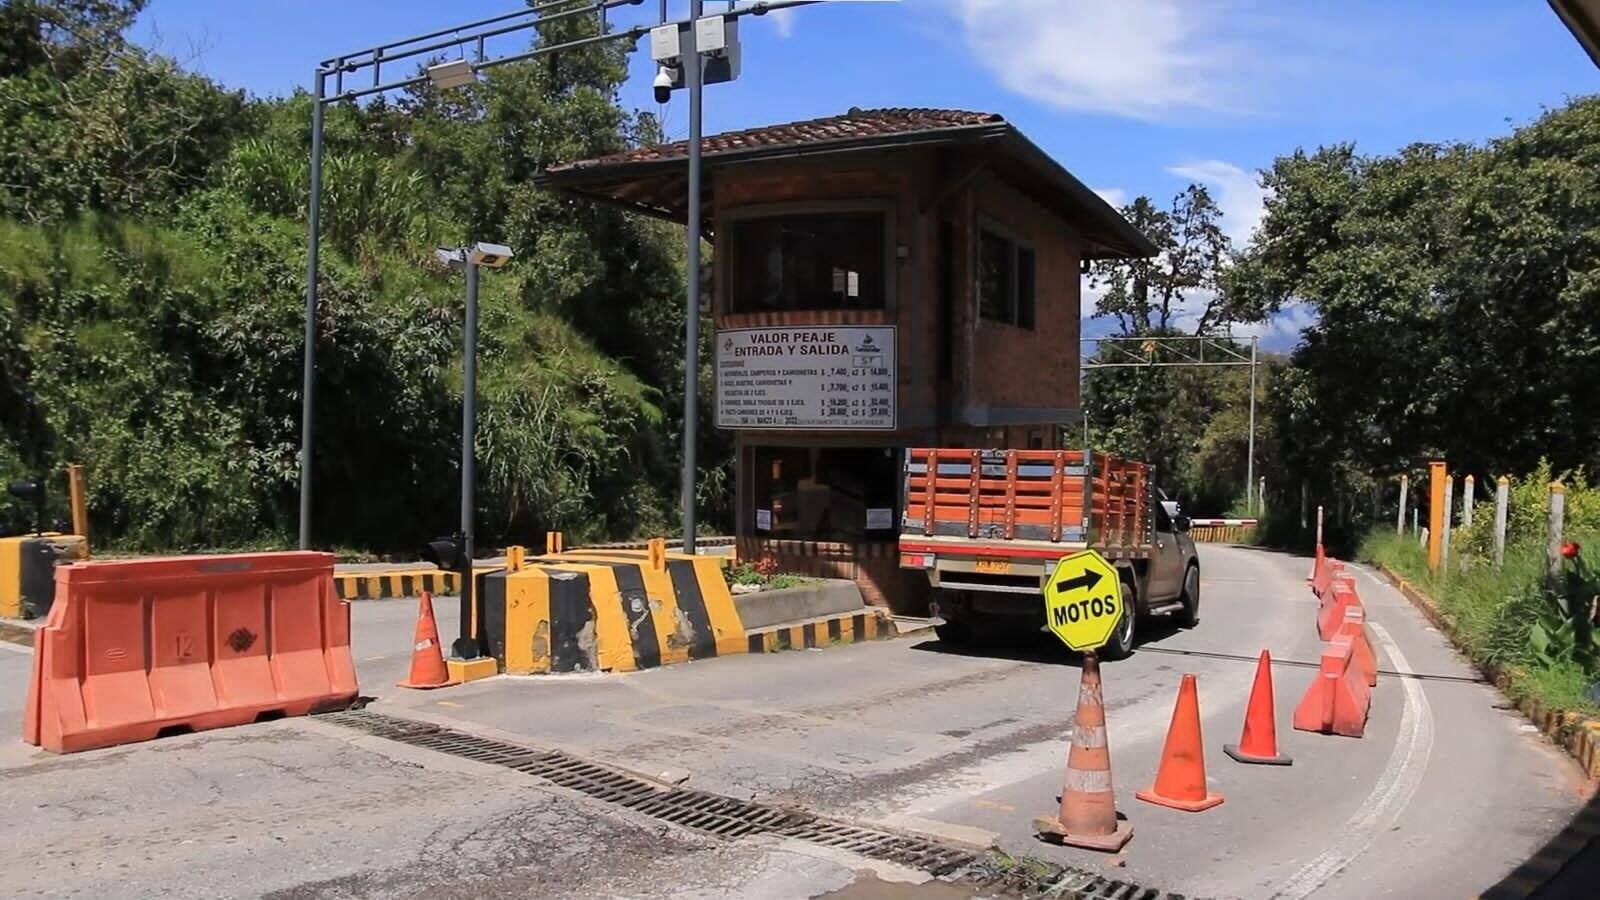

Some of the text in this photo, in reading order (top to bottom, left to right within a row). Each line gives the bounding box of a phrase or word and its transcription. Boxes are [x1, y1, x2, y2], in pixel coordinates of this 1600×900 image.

[750, 332, 835, 344] VALOR PEAJE
[735, 345, 783, 357] ENTRADA
[788, 345, 796, 356] Y
[800, 344, 849, 356] SALIDA
[1054, 594, 1116, 627] MOTOS
